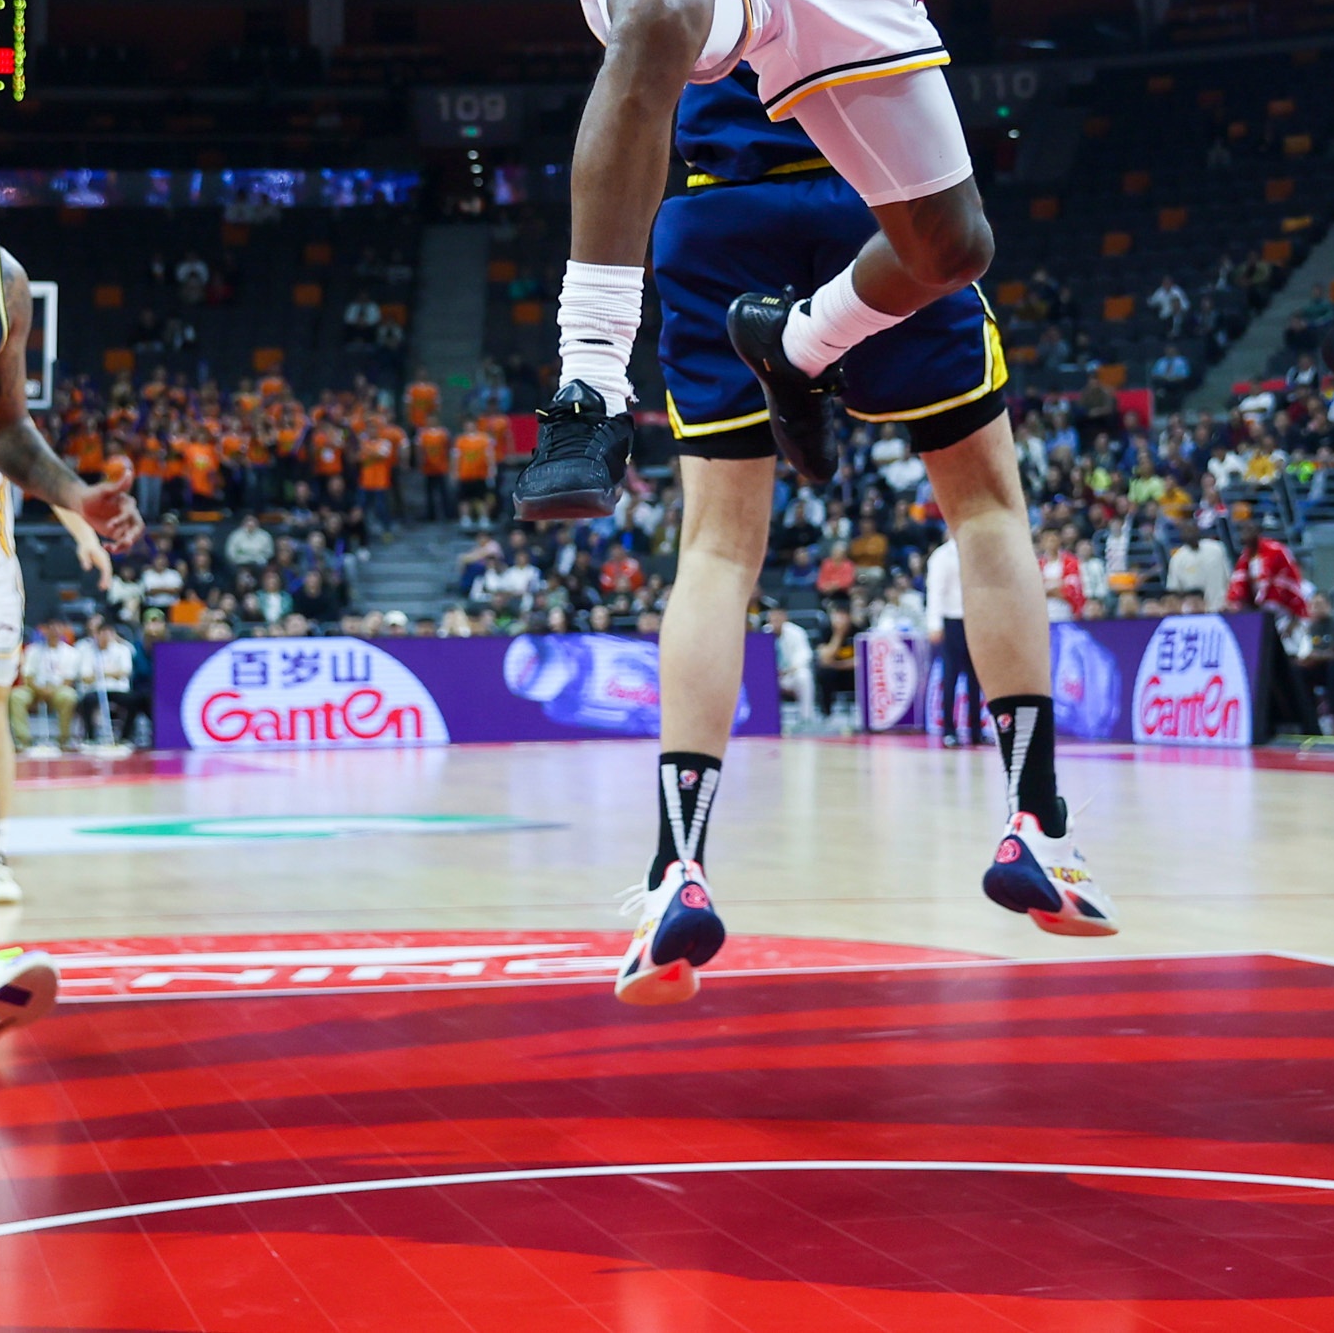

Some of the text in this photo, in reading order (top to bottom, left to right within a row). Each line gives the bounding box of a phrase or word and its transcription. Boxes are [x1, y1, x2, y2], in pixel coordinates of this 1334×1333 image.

[437, 92, 507, 122] 109
[1155, 627, 1223, 672] 百岁山
[231, 650, 372, 688] 百岁山
